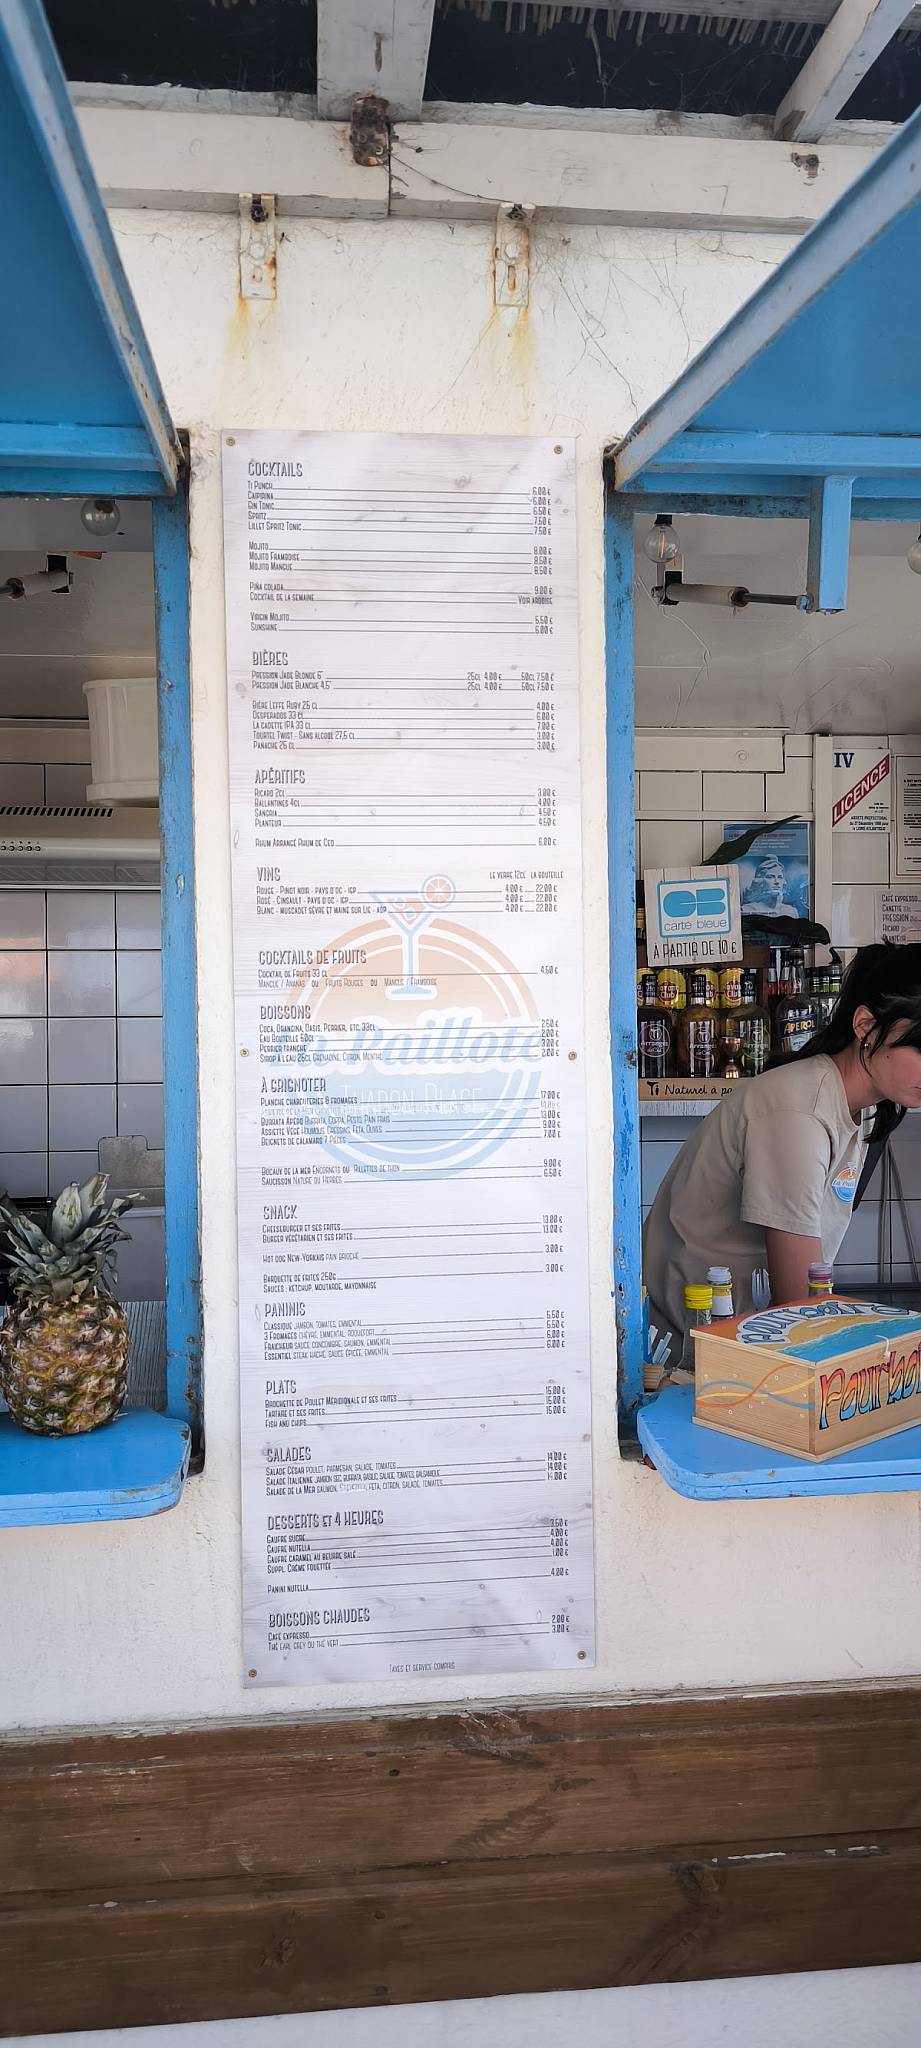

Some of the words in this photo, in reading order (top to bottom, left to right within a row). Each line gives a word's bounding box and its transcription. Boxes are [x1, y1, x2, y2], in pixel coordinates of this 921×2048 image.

[248, 462, 303, 477] COCKTAILS
[253, 649, 288, 665] BIÈRES
[834, 752, 854, 768] IV
[255, 768, 305, 784] APÉRITIFS
[833, 758, 888, 824] LICENCE
[257, 867, 280, 881] VINS
[664, 922, 691, 931] carte
[697, 919, 727, 929] bleue
[654, 943, 659, 959] À
[664, 942, 698, 958] PARTIR
[702, 941, 715, 955] DE
[719, 940, 728, 954] 10
[259, 951, 313, 965] COCKTAILS
[316, 951, 329, 964] DE
[332, 950, 367, 964] FRUITS
[260, 1006, 311, 1019] BOISSONS
[784, 1020, 815, 1033] APEROL
[261, 1077, 267, 1092] À
[271, 1078, 326, 1092] GRIGNOTER
[647, 1081, 659, 1095] Ti
[665, 1084, 707, 1095] Naturel
[263, 1205, 298, 1220] SNACK
[265, 1302, 306, 1317] PANINIS
[266, 1380, 296, 1394] PLATS
[267, 1447, 311, 1462] SALADES
[268, 1513, 319, 1530] DESSERTS
[323, 1514, 332, 1527] ET
[334, 1512, 341, 1526] 4
[345, 1510, 384, 1525] HEURES
[269, 1610, 320, 1627] BOISSONS
[323, 1608, 370, 1624] CHAUDES
